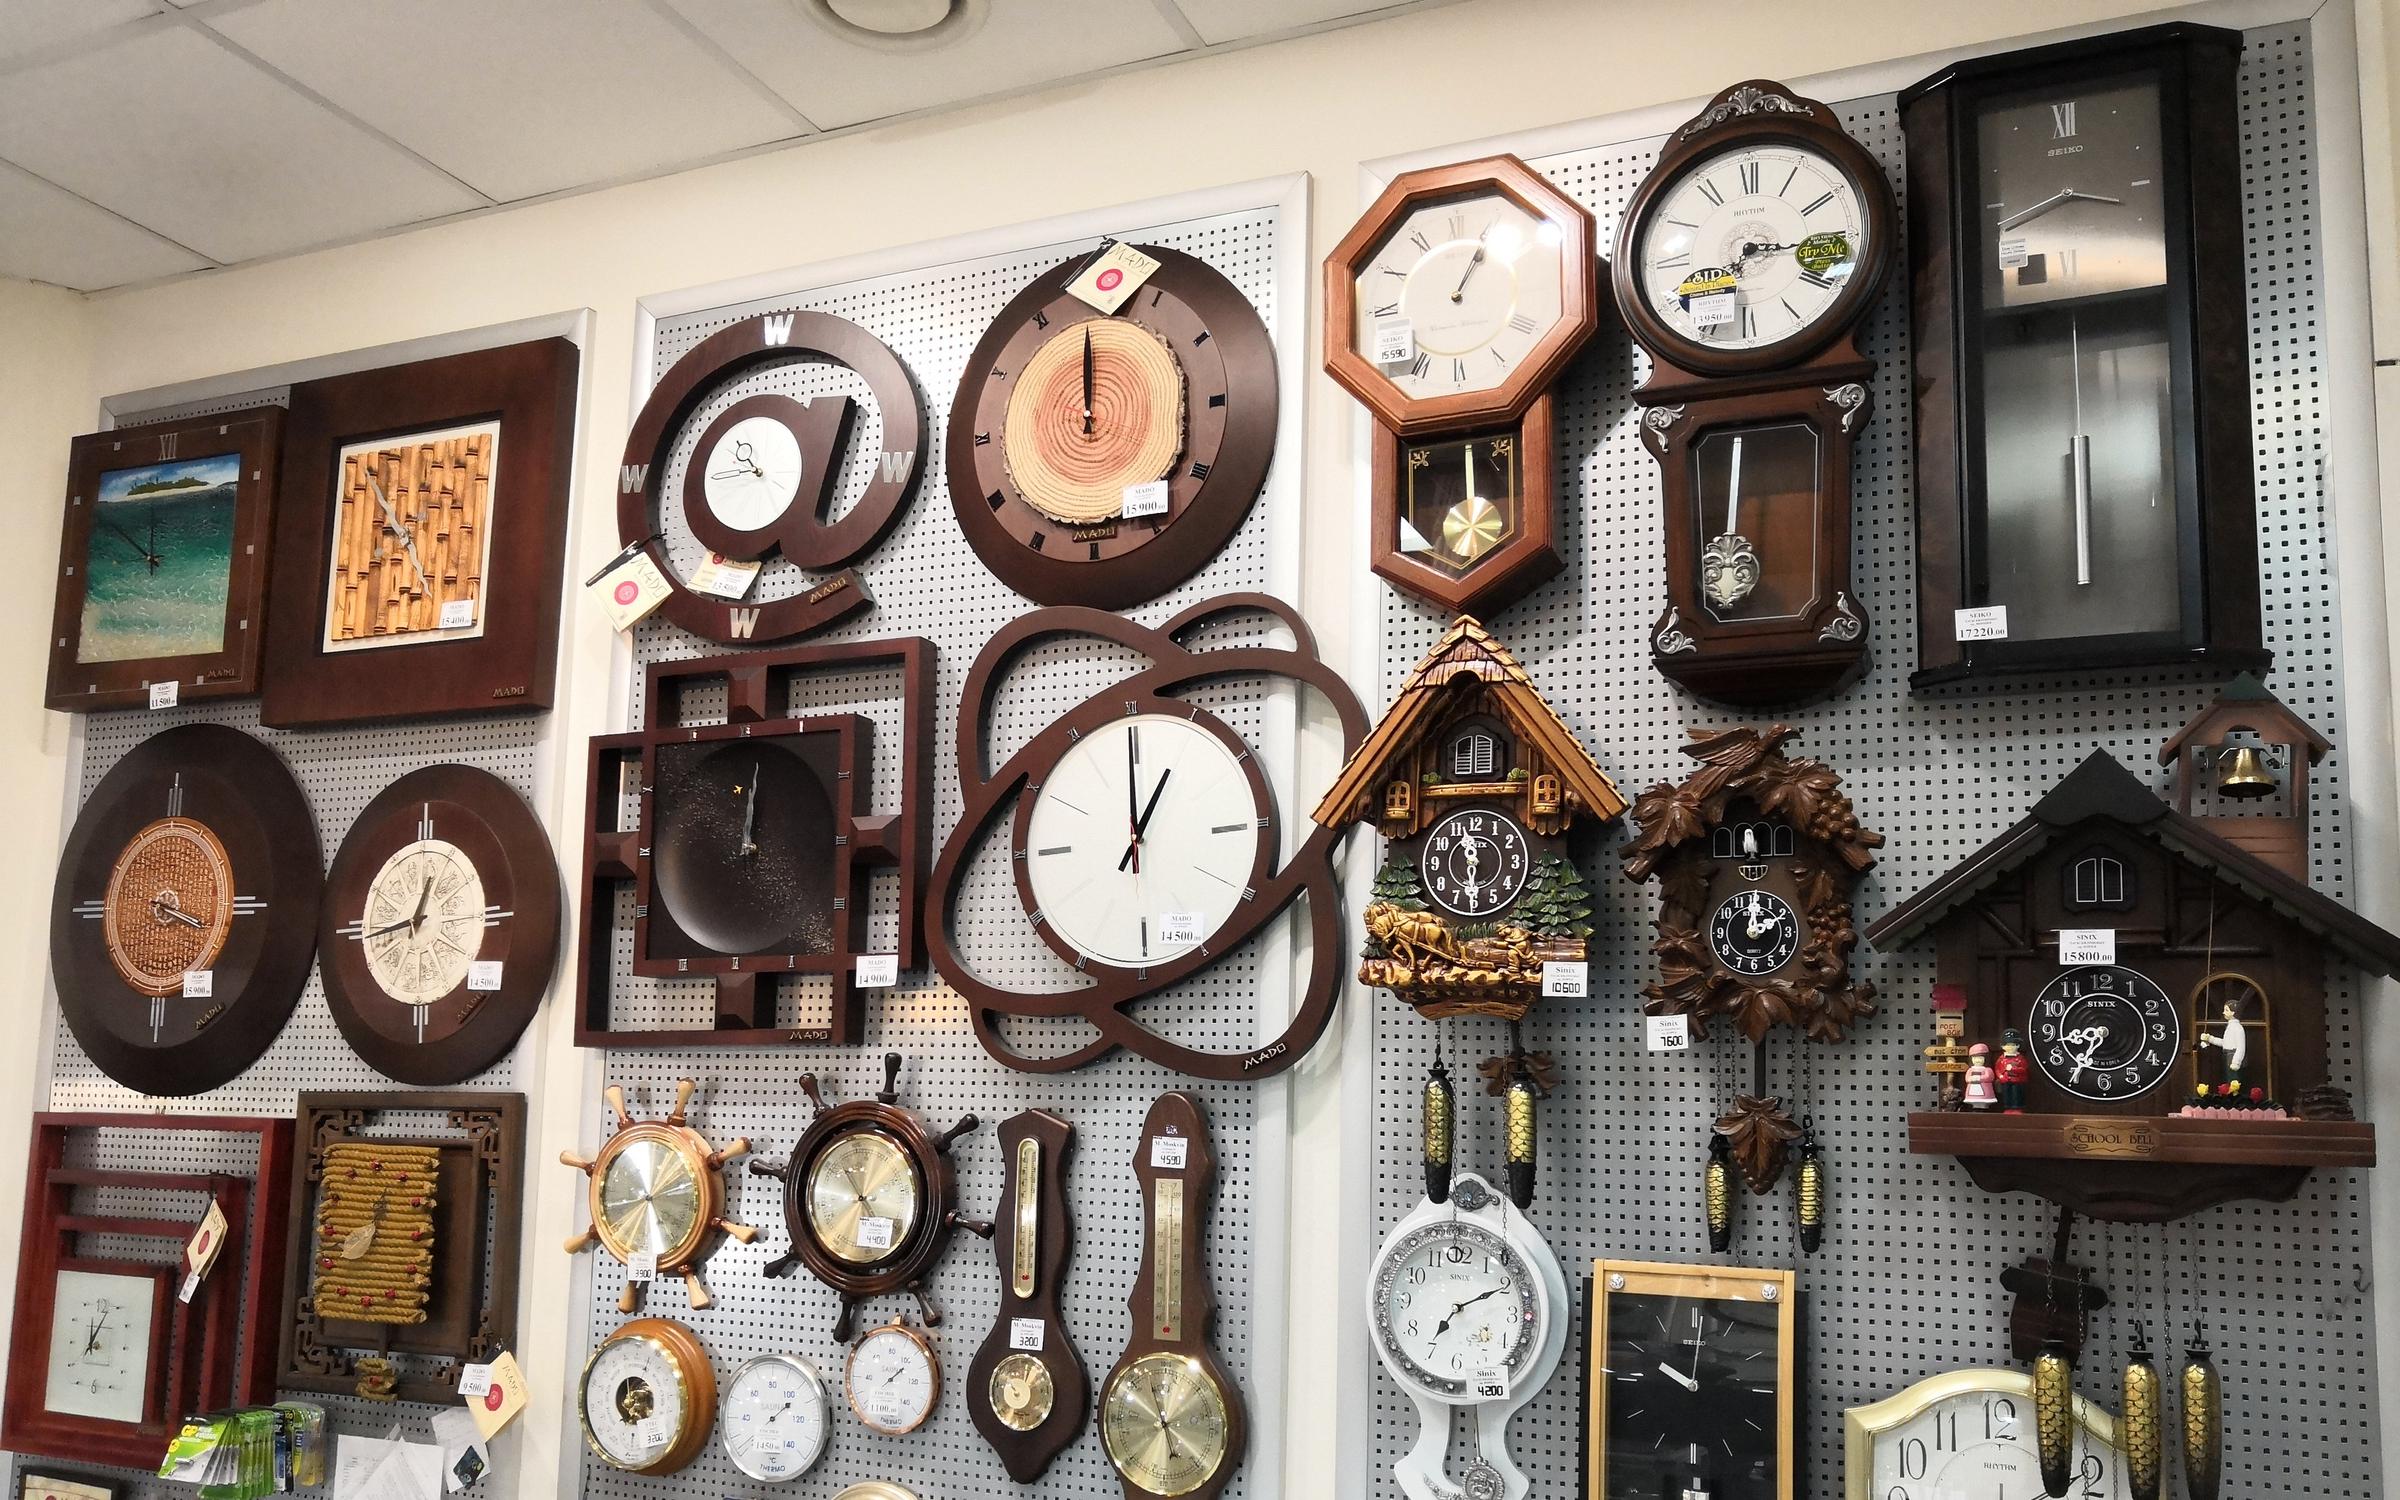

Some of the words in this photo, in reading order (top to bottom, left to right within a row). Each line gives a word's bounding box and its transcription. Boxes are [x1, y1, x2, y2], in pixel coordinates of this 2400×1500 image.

[2050, 101, 2079, 139] XII
[2047, 145, 2084, 157] SEIKO
[1733, 206, 1766, 217] RHYTHM
[1107, 245, 1155, 275] MADO
[764, 313, 795, 346] W
[159, 432, 179, 461] XII
[882, 450, 914, 484] W
[621, 463, 649, 494] W
[1073, 527, 1116, 541] MADO
[809, 576, 846, 603] MADO
[729, 607, 760, 639] W
[493, 686, 525, 698] MADO
[1450, 822, 1462, 837] 11
[1469, 816, 1483, 832] 12
[1491, 820, 1499, 836] 1
[1435, 837, 1449, 852] 10
[1505, 834, 1515, 849] 2
[1430, 856, 1440, 871] 9
[1511, 854, 1520, 869] 3
[1436, 876, 1446, 892] 8
[1503, 875, 1512, 890] 4
[1452, 889, 1460, 905] 7
[1489, 888, 1498, 904] 5
[1734, 896, 1744, 908] 11
[1767, 897, 1774, 910] 1
[1171, 914, 1193, 923] MADO
[1720, 907, 1732, 920] 10
[1717, 927, 1724, 939] 9
[1785, 926, 1792, 938] 3
[2076, 933, 2097, 941] SINIX
[1722, 944, 1730, 956] 8
[1779, 944, 1787, 956] 4
[2064, 951, 2112, 962] 15800.00
[1736, 957, 1743, 968] 7
[1750, 959, 1758, 971] 6
[1767, 955, 1775, 967] 5
[1555, 966, 1575, 974] Sinix
[2061, 980, 2082, 998] 11
[2090, 974, 2114, 991] 12
[2126, 980, 2136, 997] 1
[2043, 1000, 2065, 1018] 10
[2145, 1000, 2159, 1016] 2
[789, 1030, 828, 1040] MADO
[2042, 1023, 2056, 1043] 9
[2152, 1023, 2166, 1041] 3
[1243, 1042, 1287, 1070] MADO
[2050, 1046, 2064, 1066] 8
[2145, 1050, 2160, 1066] 4
[2097, 1073, 2112, 1092] 6
[2125, 1066, 2140, 1085] 5
[2071, 1132, 2122, 1144] SCHOOL
[2129, 1134, 2154, 1145] BELL
[1428, 1249, 1442, 1267] 11
[1483, 1256, 1490, 1274] 1
[1450, 1273, 1470, 1281] SINIX
[1507, 1305, 1518, 1324] 3
[1407, 1319, 1418, 1337] 8
[1428, 1341, 1437, 1359] 7
[1451, 1352, 1463, 1370] 6
[783, 1390, 796, 1399] 100
[1478, 1386, 1504, 1396] 4200
[792, 1415, 805, 1424] 120
[1983, 1398, 2017, 1441] 12
[1935, 1410, 1957, 1452] 11
[783, 1440, 796, 1449] 140
[1898, 1437, 1928, 1480] 10
[1983, 1461, 2017, 1472] RHYTHM
[760, 1463, 787, 1473] THERMO
